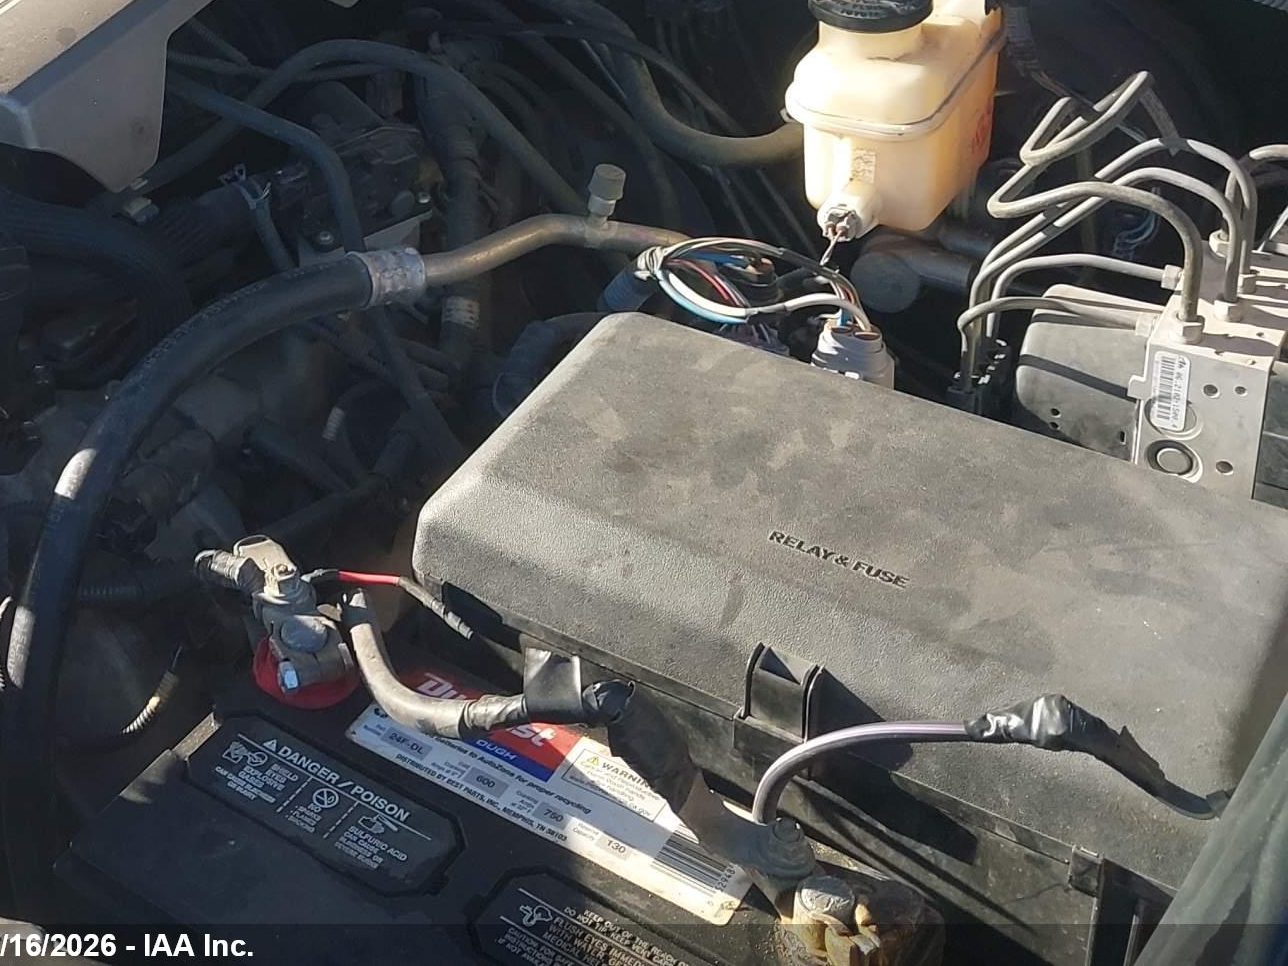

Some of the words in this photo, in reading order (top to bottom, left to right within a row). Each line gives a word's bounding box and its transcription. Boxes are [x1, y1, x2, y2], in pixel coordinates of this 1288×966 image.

[768, 530, 836, 561] RELAY
[852, 560, 911, 589] FUSE
[270, 763, 299, 782] SHIELD
[277, 745, 341, 784] DANGER
[350, 785, 411, 822] POISON
[476, 774, 496, 788] 600
[477, 756, 514, 778] AutoZone
[514, 773, 527, 785] for
[524, 781, 556, 798] proper
[555, 794, 592, 815] recycling
[602, 762, 652, 788] WARNIN
[307, 802, 322, 813] NO
[396, 753, 437, 777] DISTRIBUTED
[436, 773, 447, 781] BY
[536, 822, 546, 832] TN
[348, 825, 389, 851] SULFURIC
[386, 846, 408, 862] ACID
[607, 840, 627, 855] 130
[542, 932, 581, 957] MEDICAL
[550, 924, 572, 942] WITH
[553, 917, 583, 938] FLUSH
[584, 934, 609, 951] EYES
[564, 907, 577, 916] DO
[576, 913, 593, 926] NOT
[610, 932, 631, 946] KEEP
[632, 943, 652, 958] VENT
[584, 910, 604, 923] KEEP
[604, 921, 621, 933] OUT
[621, 930, 633, 939] OF
[635, 937, 650, 950] THE
